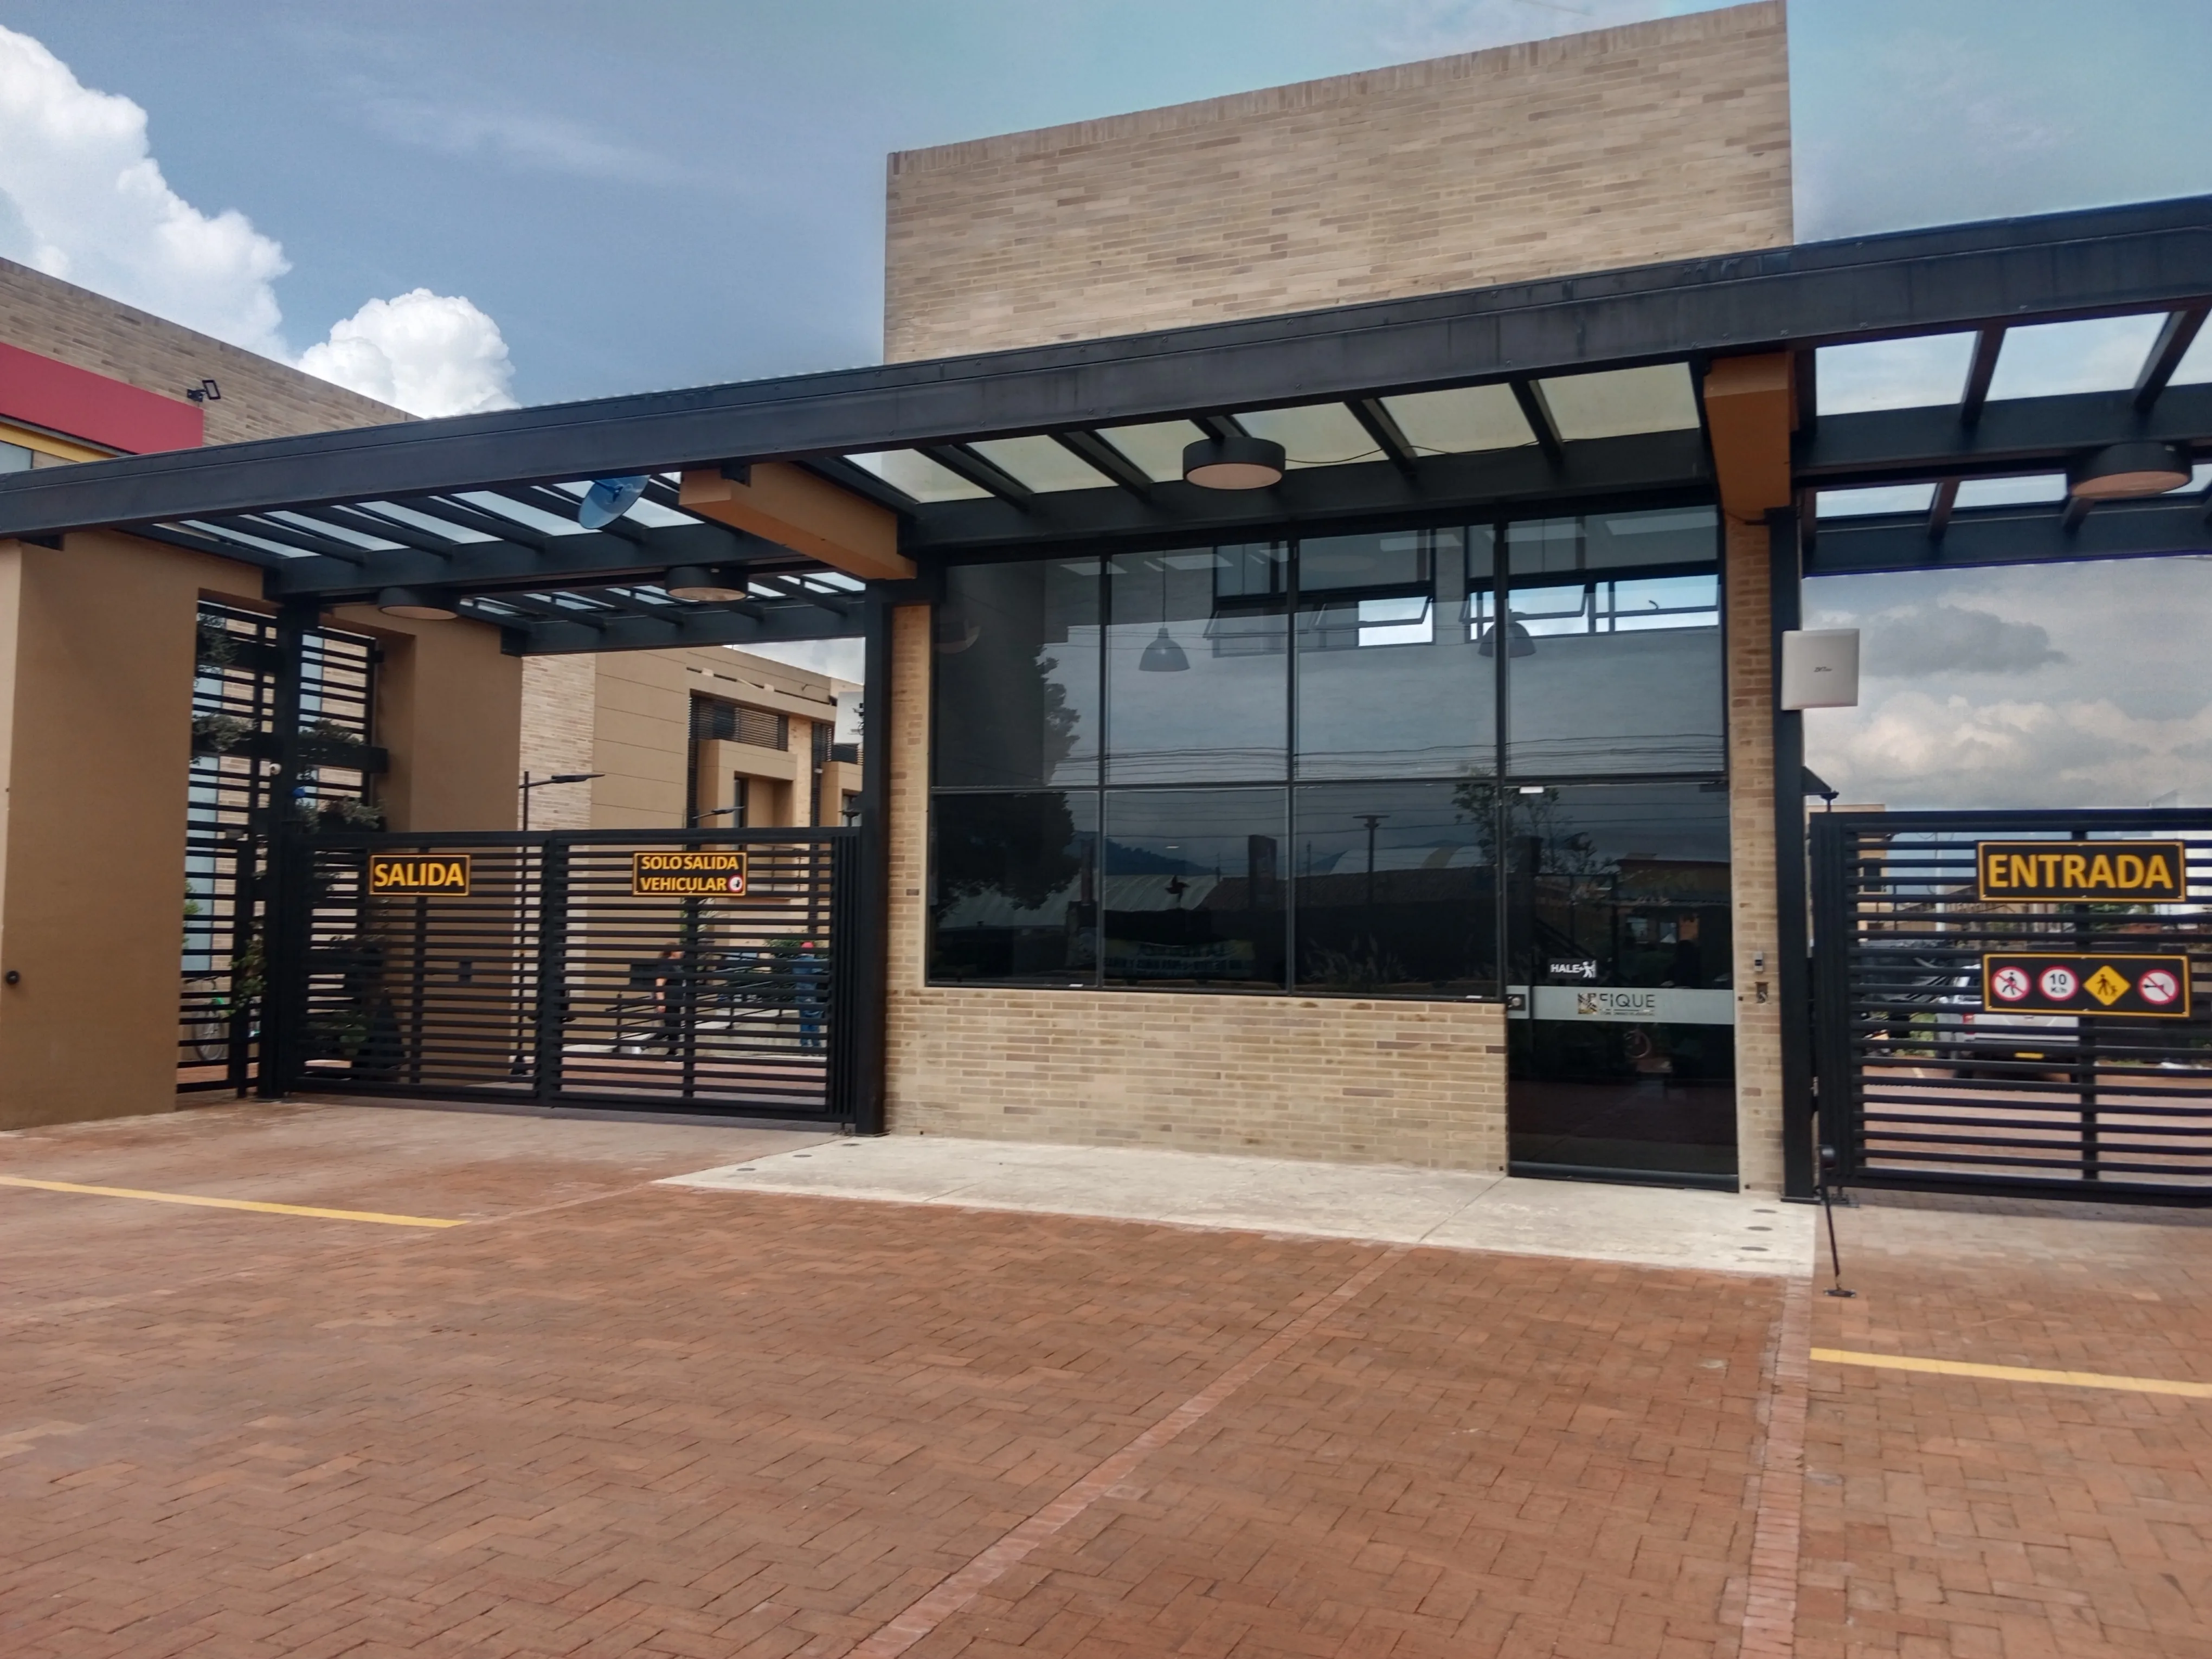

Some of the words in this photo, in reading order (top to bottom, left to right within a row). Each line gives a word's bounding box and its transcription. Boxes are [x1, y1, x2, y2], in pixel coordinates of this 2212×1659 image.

[641, 856, 683, 870] SOLO
[683, 856, 740, 870] SALIDA
[374, 863, 465, 887] SALIDA
[1988, 854, 2174, 889] ENTRADA
[640, 877, 728, 891] VEHICULAR
[1550, 963, 1580, 973] HALE
[2049, 974, 2067, 985] 10
[1599, 993, 1655, 1008] FIQUE
